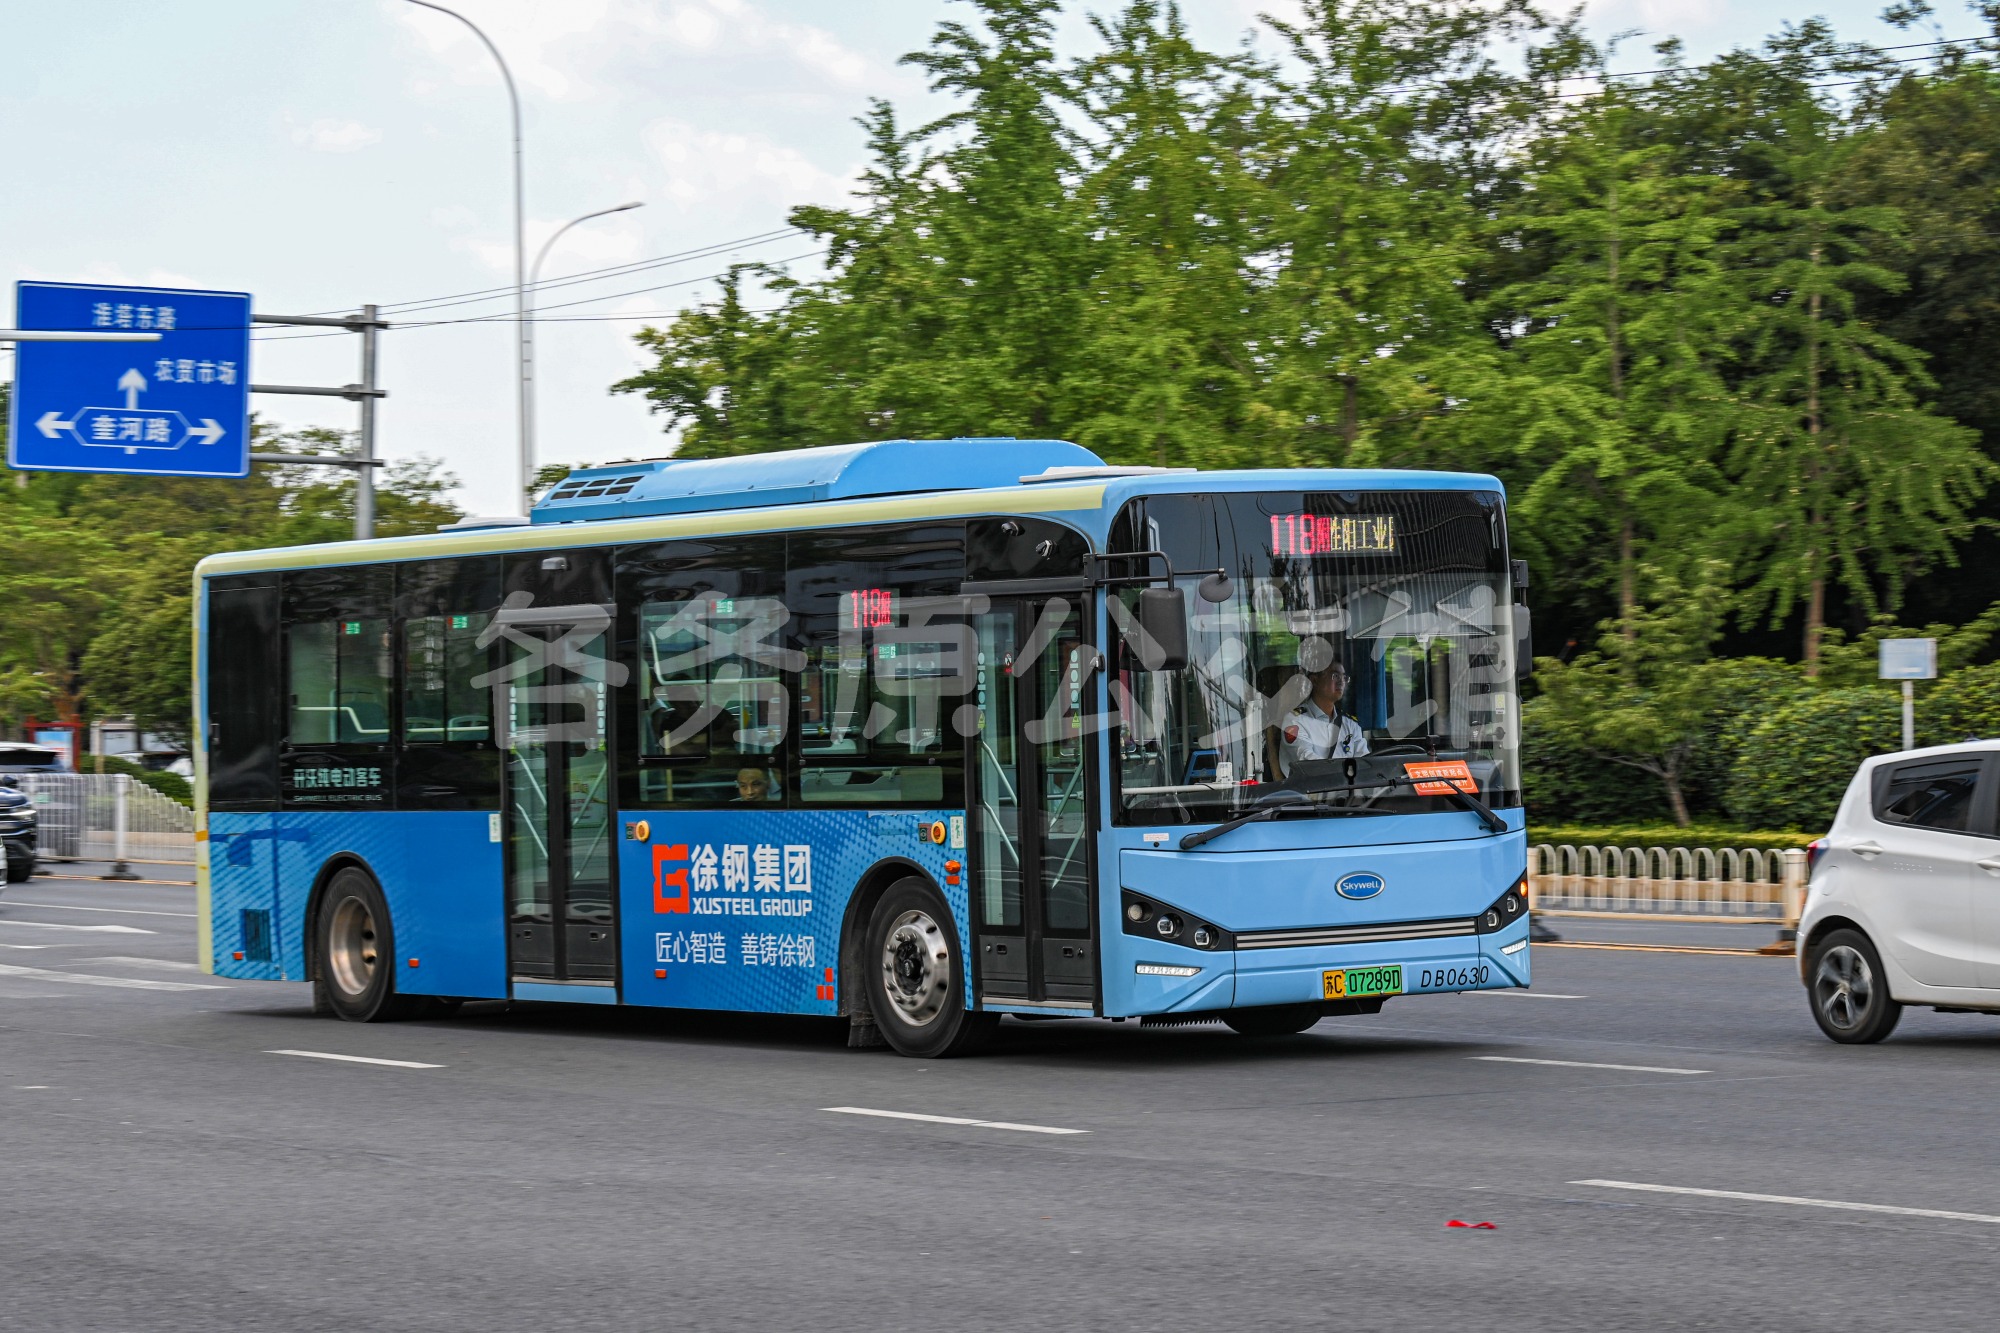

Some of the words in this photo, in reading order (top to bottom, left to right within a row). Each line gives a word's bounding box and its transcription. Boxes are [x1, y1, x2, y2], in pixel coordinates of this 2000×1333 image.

[154, 358, 237, 385] 农贸市场
[91, 414, 171, 442] 奎河路
[691, 844, 813, 893] 徐钢集团
[1342, 880, 1379, 890] Skywell
[693, 898, 759, 916] XUSTEEL
[760, 899, 813, 917] GROUP
[655, 931, 727, 964] 匠心智造
[741, 932, 816, 967] 善铸徐钢
[1420, 965, 1489, 987] DB0630
